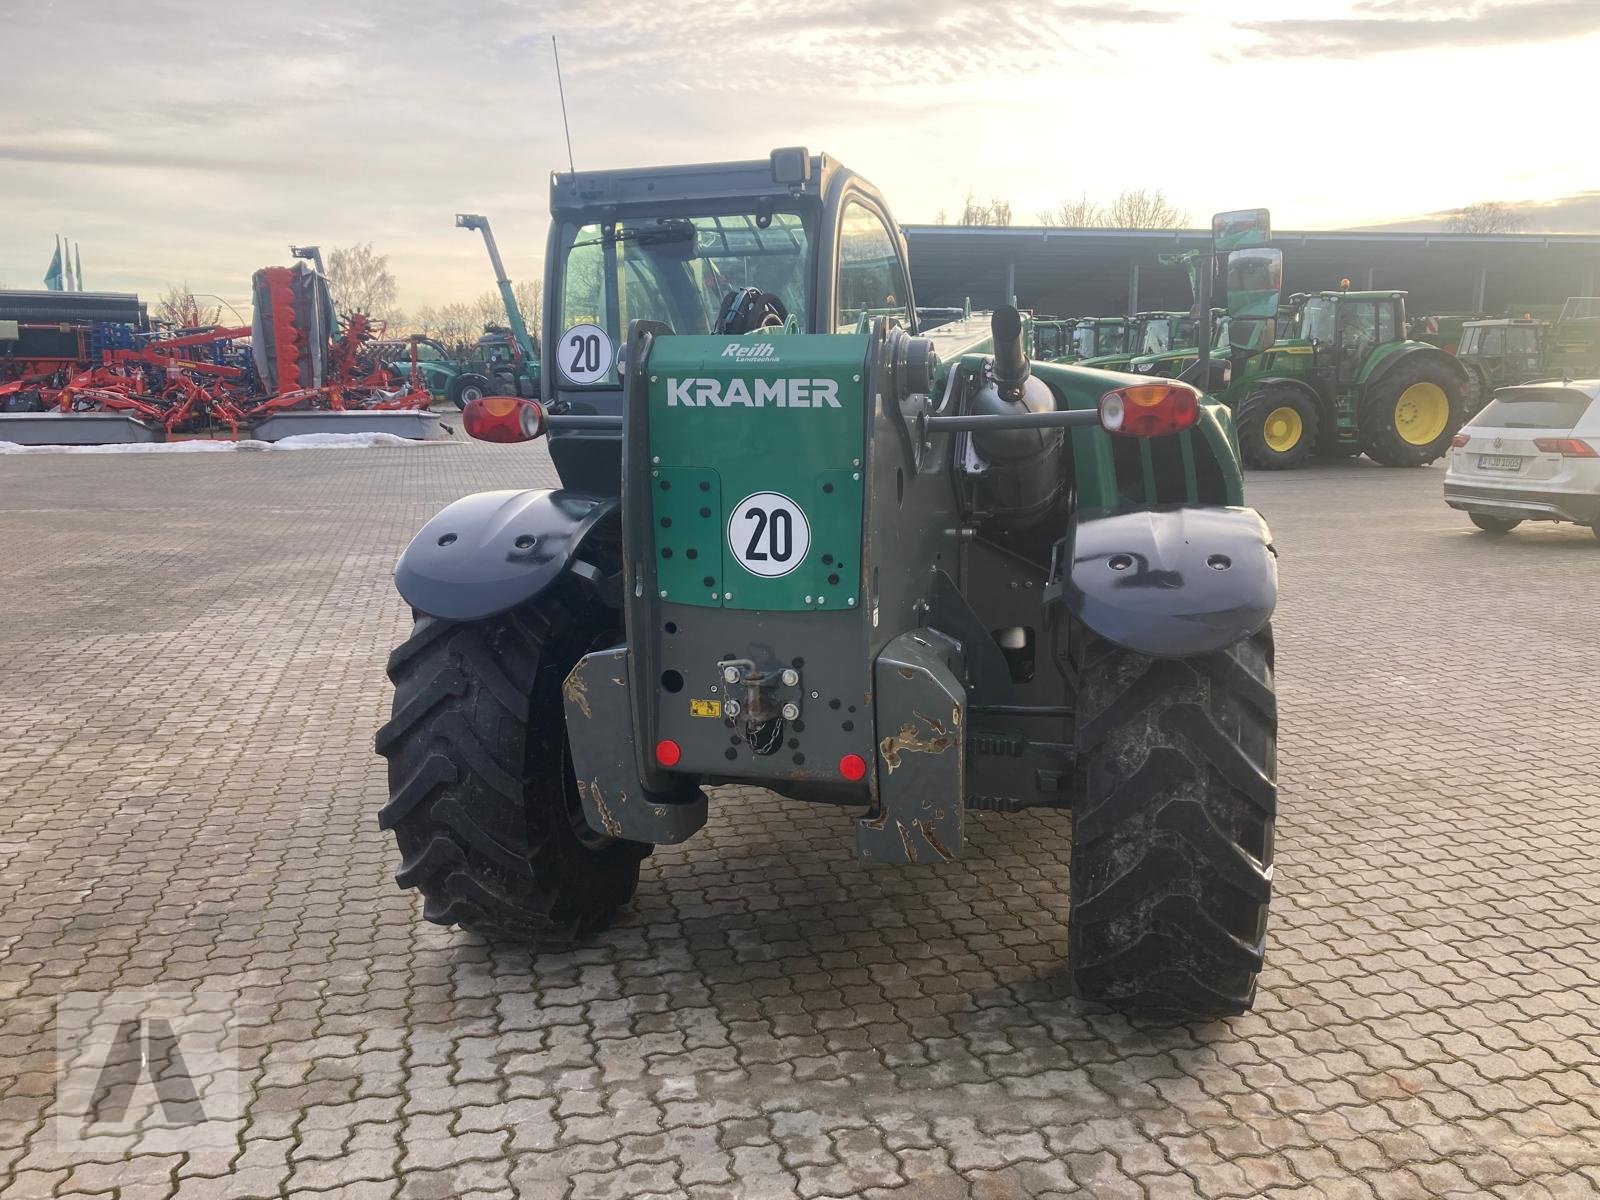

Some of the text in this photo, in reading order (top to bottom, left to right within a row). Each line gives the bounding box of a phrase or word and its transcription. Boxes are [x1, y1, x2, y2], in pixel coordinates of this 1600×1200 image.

[570, 334, 600, 373] 20
[721, 343, 775, 357] Reith
[668, 378, 842, 408] KRAMER
[745, 507, 793, 562] 20
